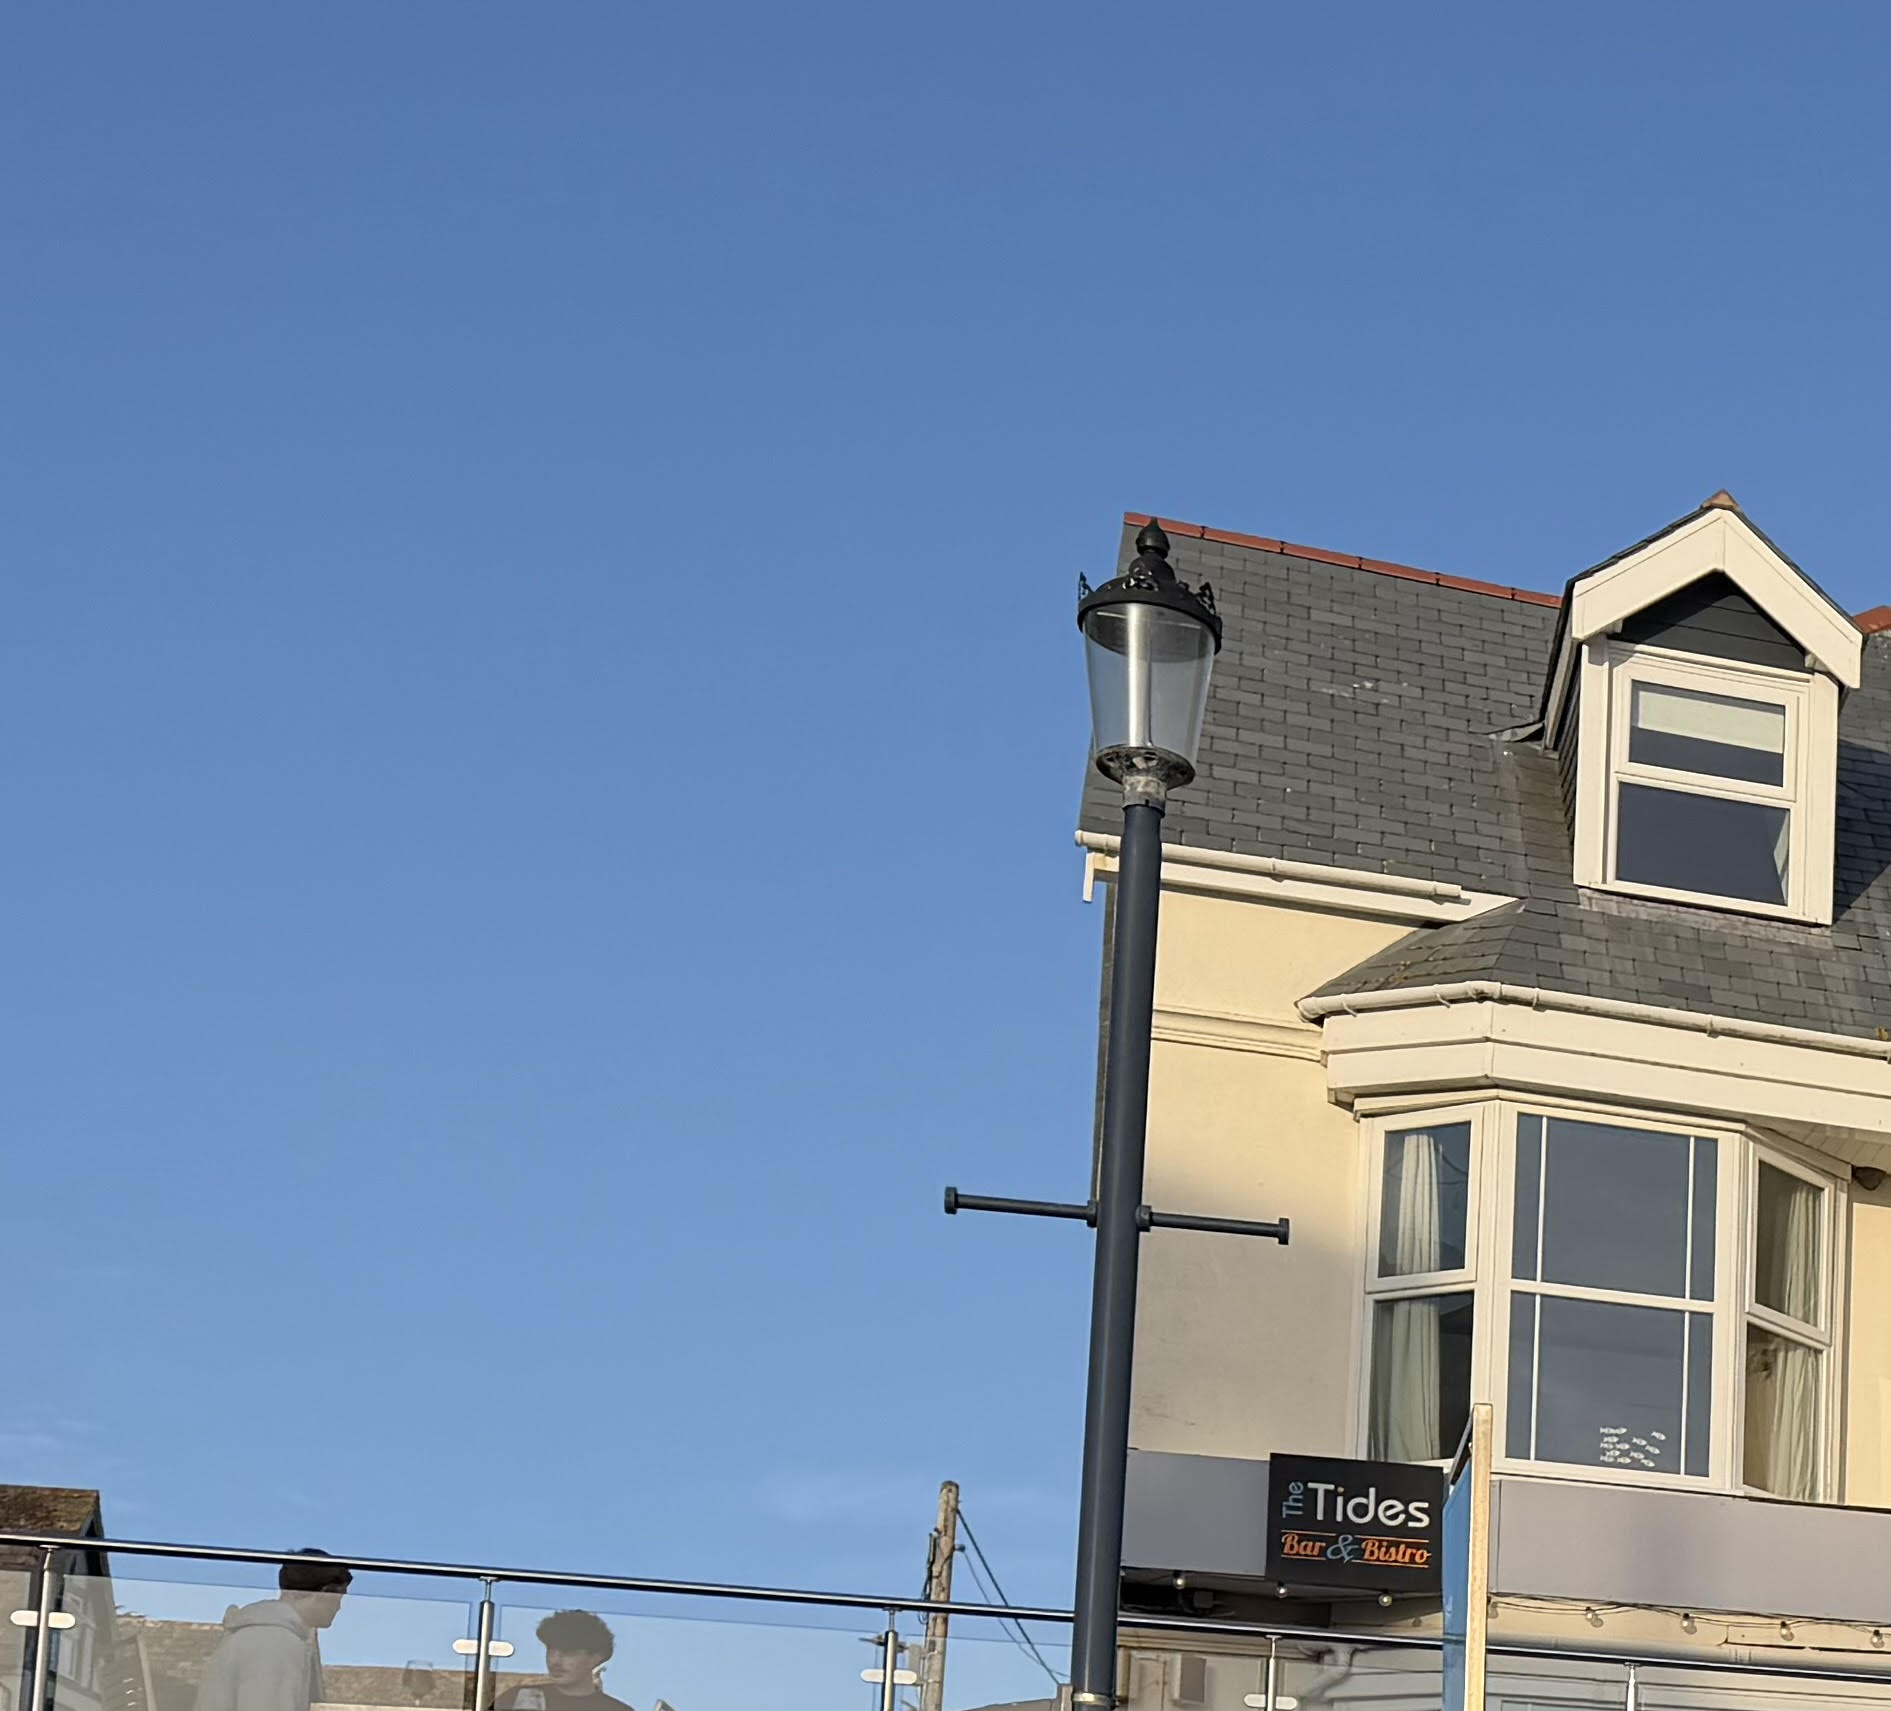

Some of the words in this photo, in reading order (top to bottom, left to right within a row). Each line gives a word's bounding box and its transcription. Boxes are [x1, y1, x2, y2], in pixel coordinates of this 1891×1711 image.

[1282, 1481, 1304, 1518] The
[1307, 1482, 1430, 1528] Tides
[1281, 1532, 1326, 1557] Bar
[1326, 1534, 1361, 1564] &
[1361, 1536, 1432, 1564] Bistro
